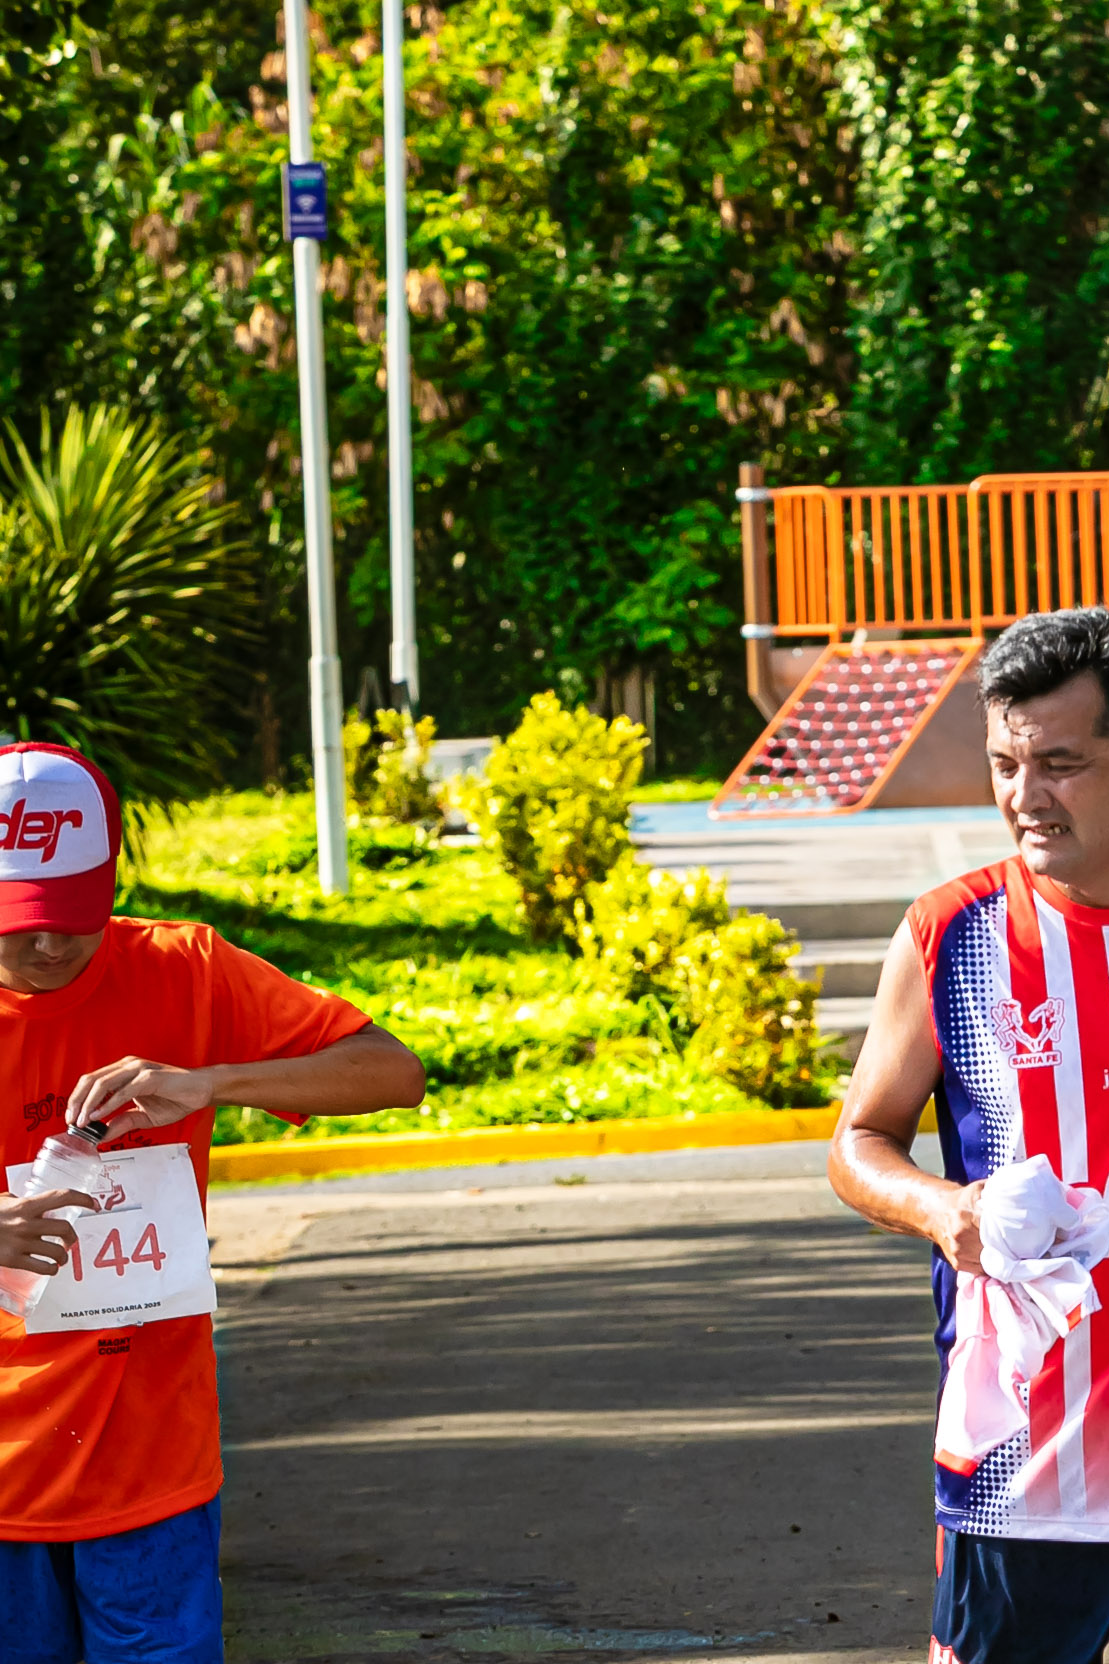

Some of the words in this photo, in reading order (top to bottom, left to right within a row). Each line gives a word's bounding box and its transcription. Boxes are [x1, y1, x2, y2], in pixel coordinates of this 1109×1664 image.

[1012, 1056, 1044, 1066] SANTA
[1046, 1055, 1059, 1063] FE
[70, 1222, 166, 1282] 144
[61, 1309, 100, 1318] MARATON
[101, 1304, 143, 1314] SOLIDARIA
[144, 1301, 161, 1309] 2025
[98, 1337, 131, 1347] MAGNY
[98, 1346, 130, 1355] COURS
